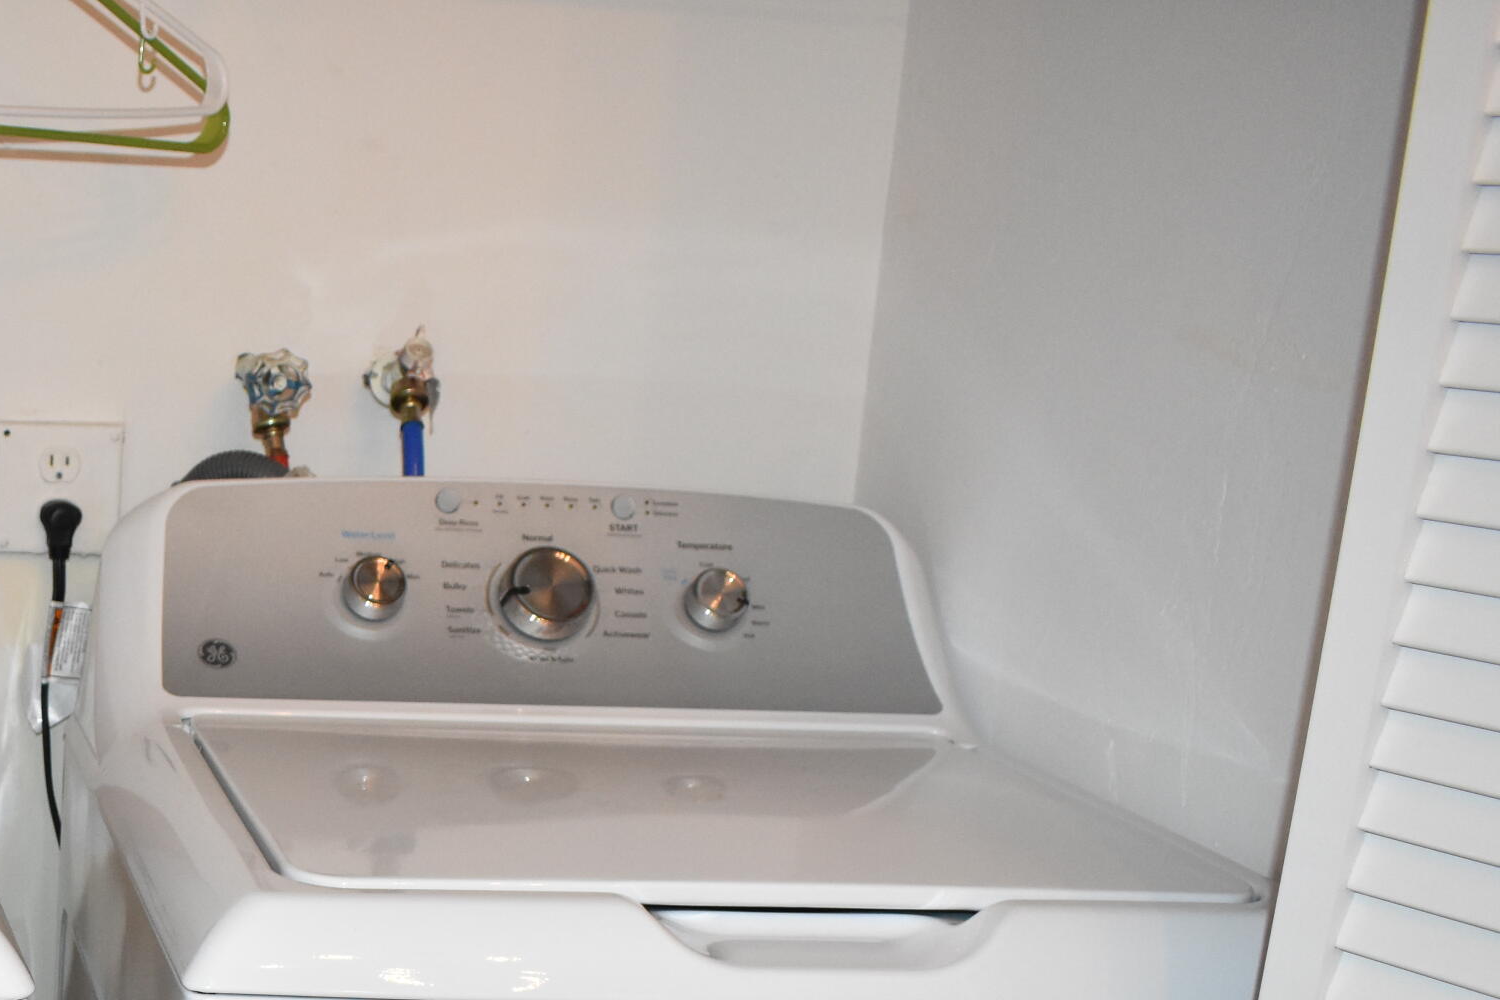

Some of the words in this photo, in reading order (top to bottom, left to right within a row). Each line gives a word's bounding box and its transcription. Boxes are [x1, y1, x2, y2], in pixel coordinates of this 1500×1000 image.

[609, 523, 639, 533] START
[522, 533, 554, 543] Normal
[676, 539, 733, 552] Temperature
